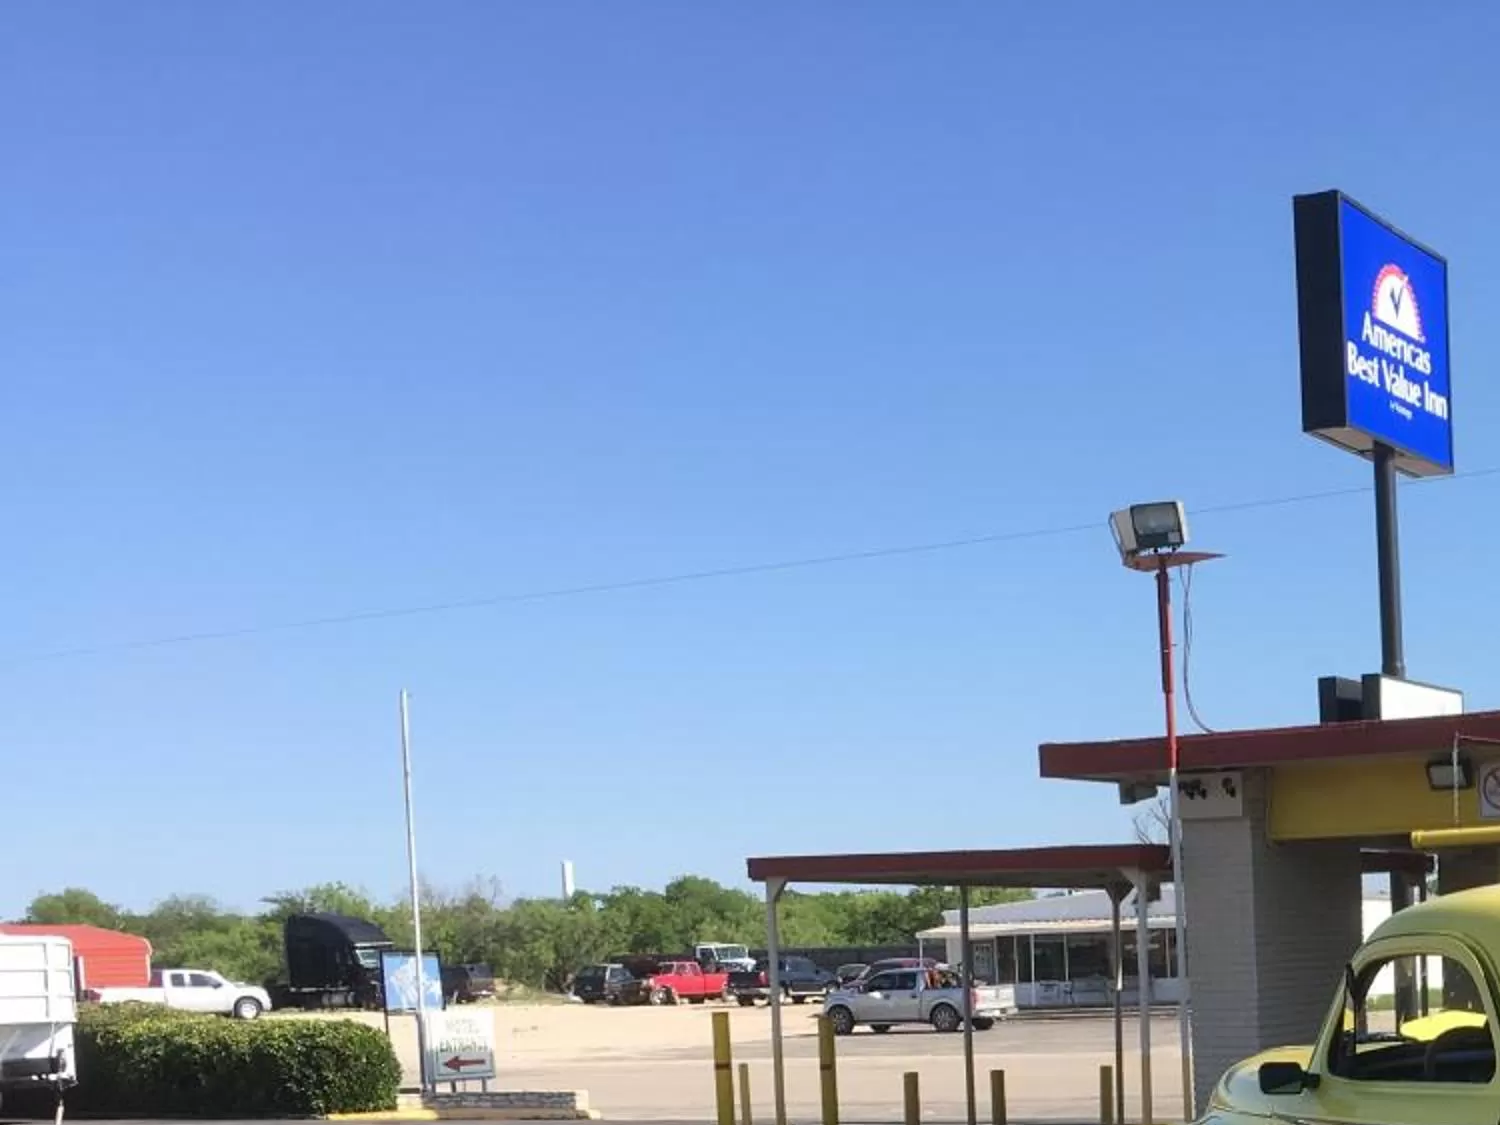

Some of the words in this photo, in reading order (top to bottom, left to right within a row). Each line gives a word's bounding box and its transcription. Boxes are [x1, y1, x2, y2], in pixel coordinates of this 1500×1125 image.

[1362, 311, 1431, 375] Americas
[1347, 340, 1380, 388] Best
[1381, 358, 1422, 408] Value
[1424, 380, 1448, 420] Inn
